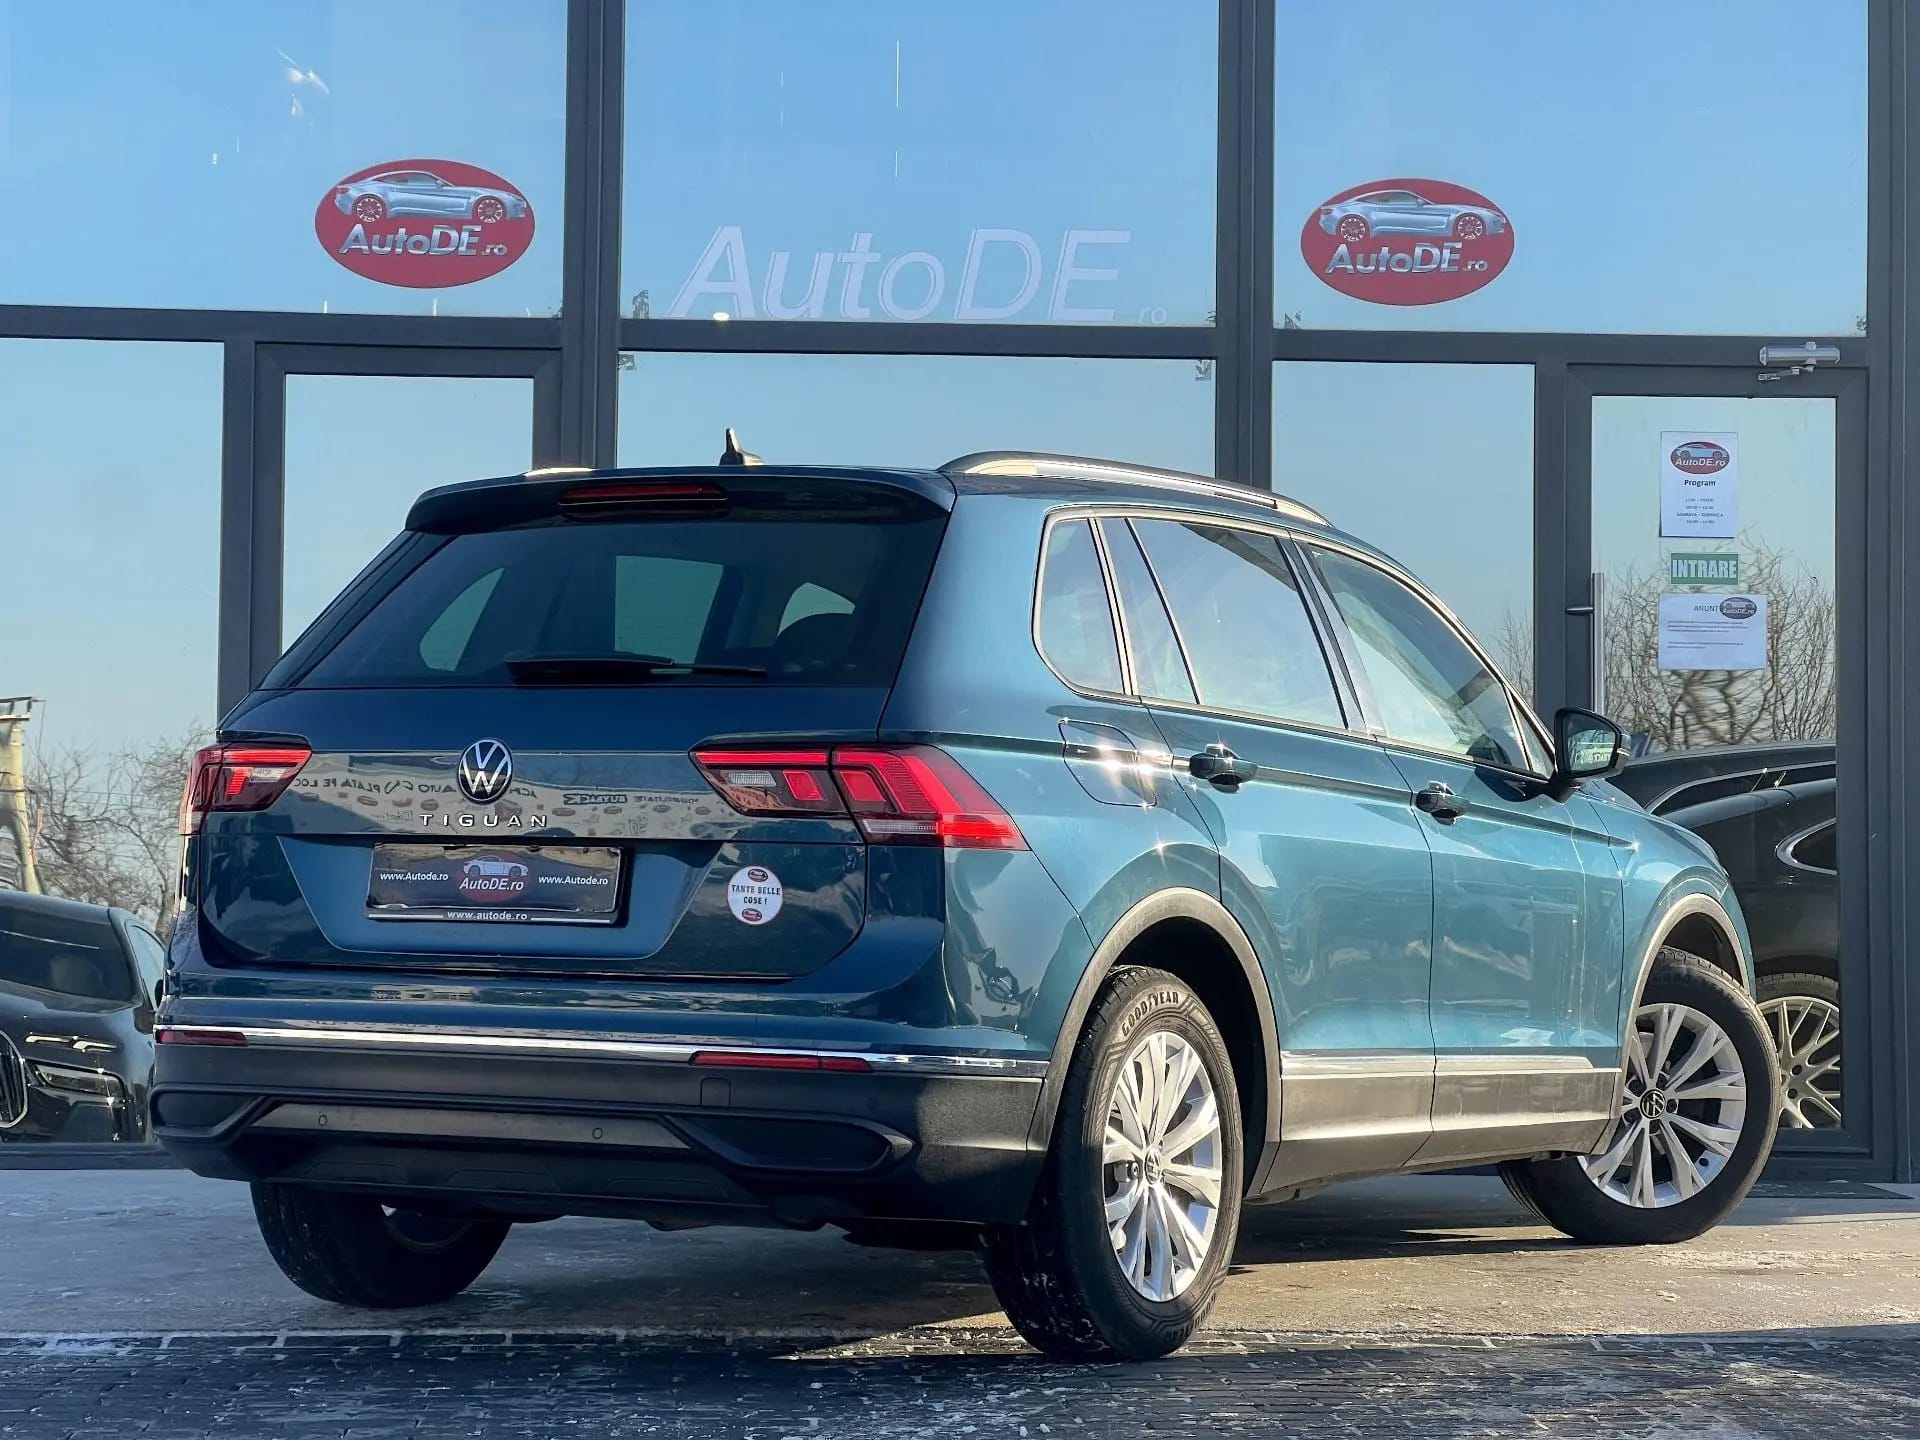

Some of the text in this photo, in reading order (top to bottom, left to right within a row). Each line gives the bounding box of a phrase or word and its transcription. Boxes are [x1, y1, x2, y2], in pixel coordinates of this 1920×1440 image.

[1684, 479, 1716, 487] Program
[1672, 559, 1737, 578] INTRARE
[419, 814, 547, 828] TIGUAN
[380, 872, 449, 881] www.Autode.ro
[538, 875, 609, 886] www.Autode.ro
[459, 877, 524, 891] AutoDE.ro
[731, 884, 755, 894] TANTE
[447, 910, 528, 921] www.autode.ro
